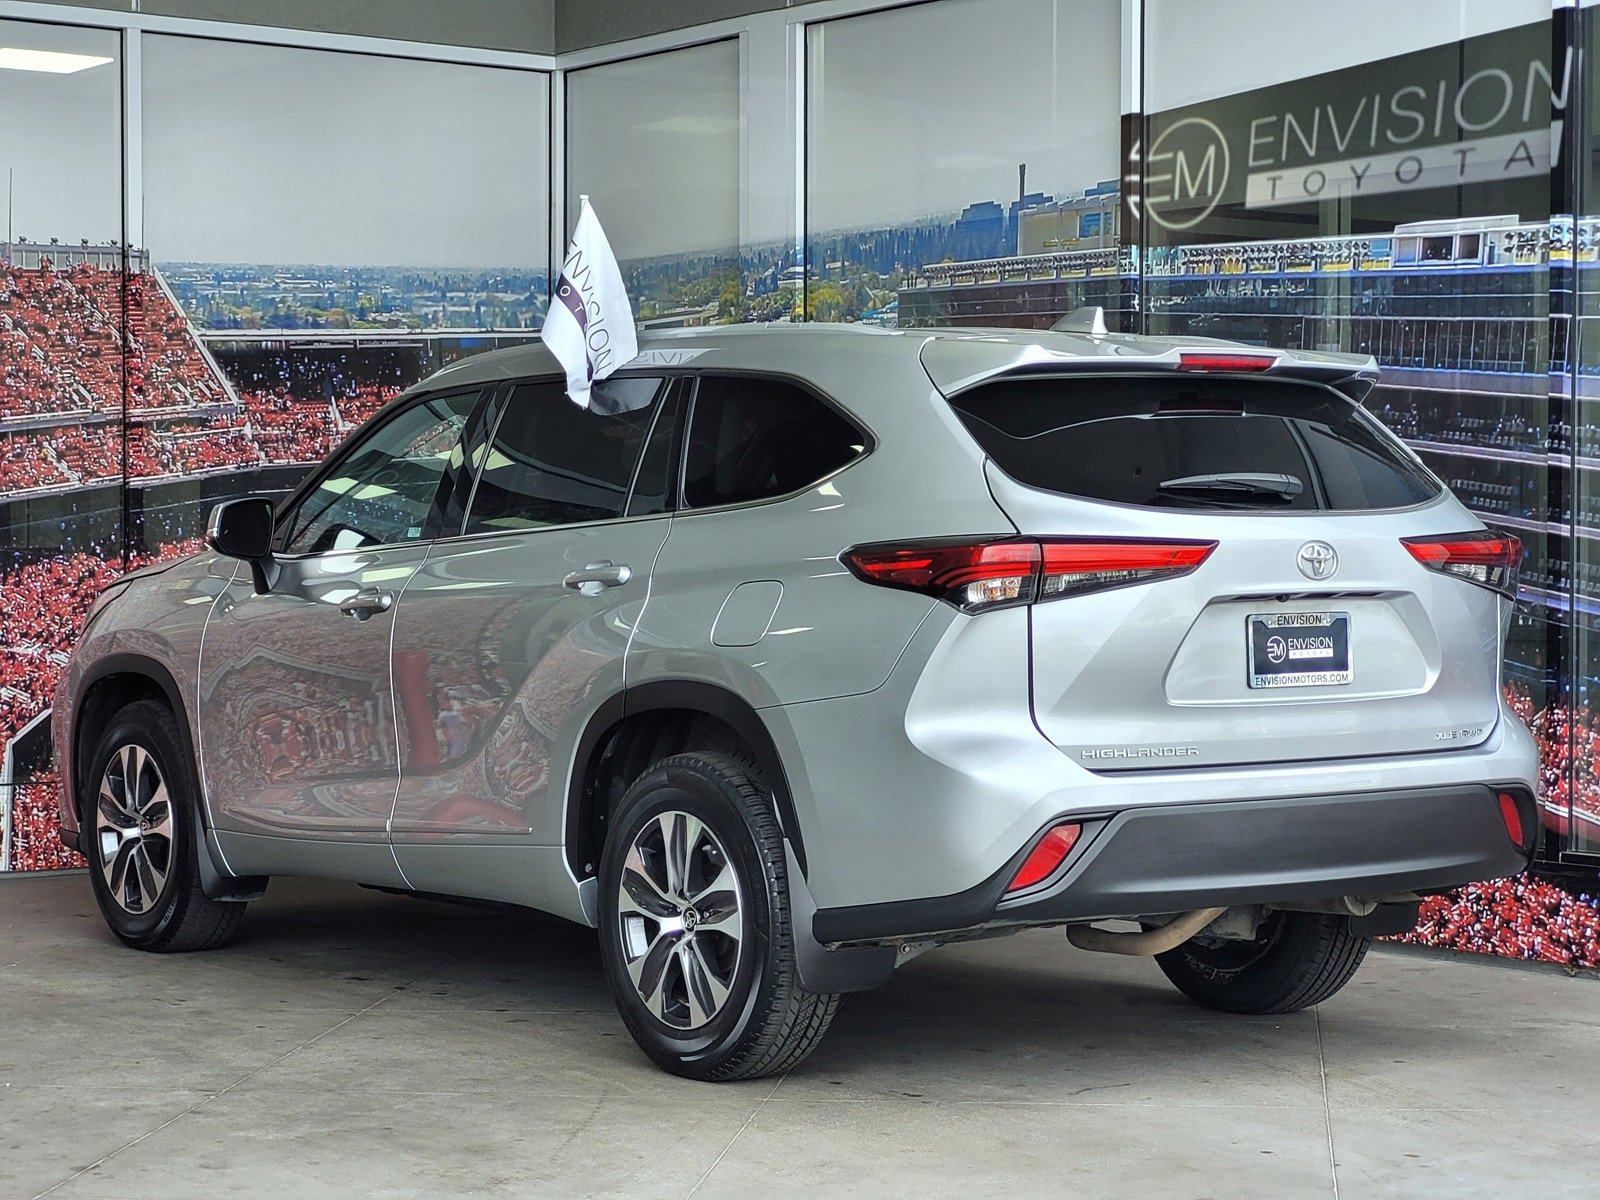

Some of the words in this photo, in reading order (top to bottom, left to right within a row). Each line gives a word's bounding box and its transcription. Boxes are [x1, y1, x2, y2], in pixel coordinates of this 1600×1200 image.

[1248, 46, 1572, 167] ENVISION
[1266, 138, 1536, 201] TOYOTA
[563, 239, 612, 375] NVISION
[1277, 615, 1322, 626] ENVISION
[1288, 637, 1333, 649] ENVISION
[1255, 673, 1349, 686] ENVISIONMOTORS.COM
[1081, 745, 1200, 759] HIGHLANDER
